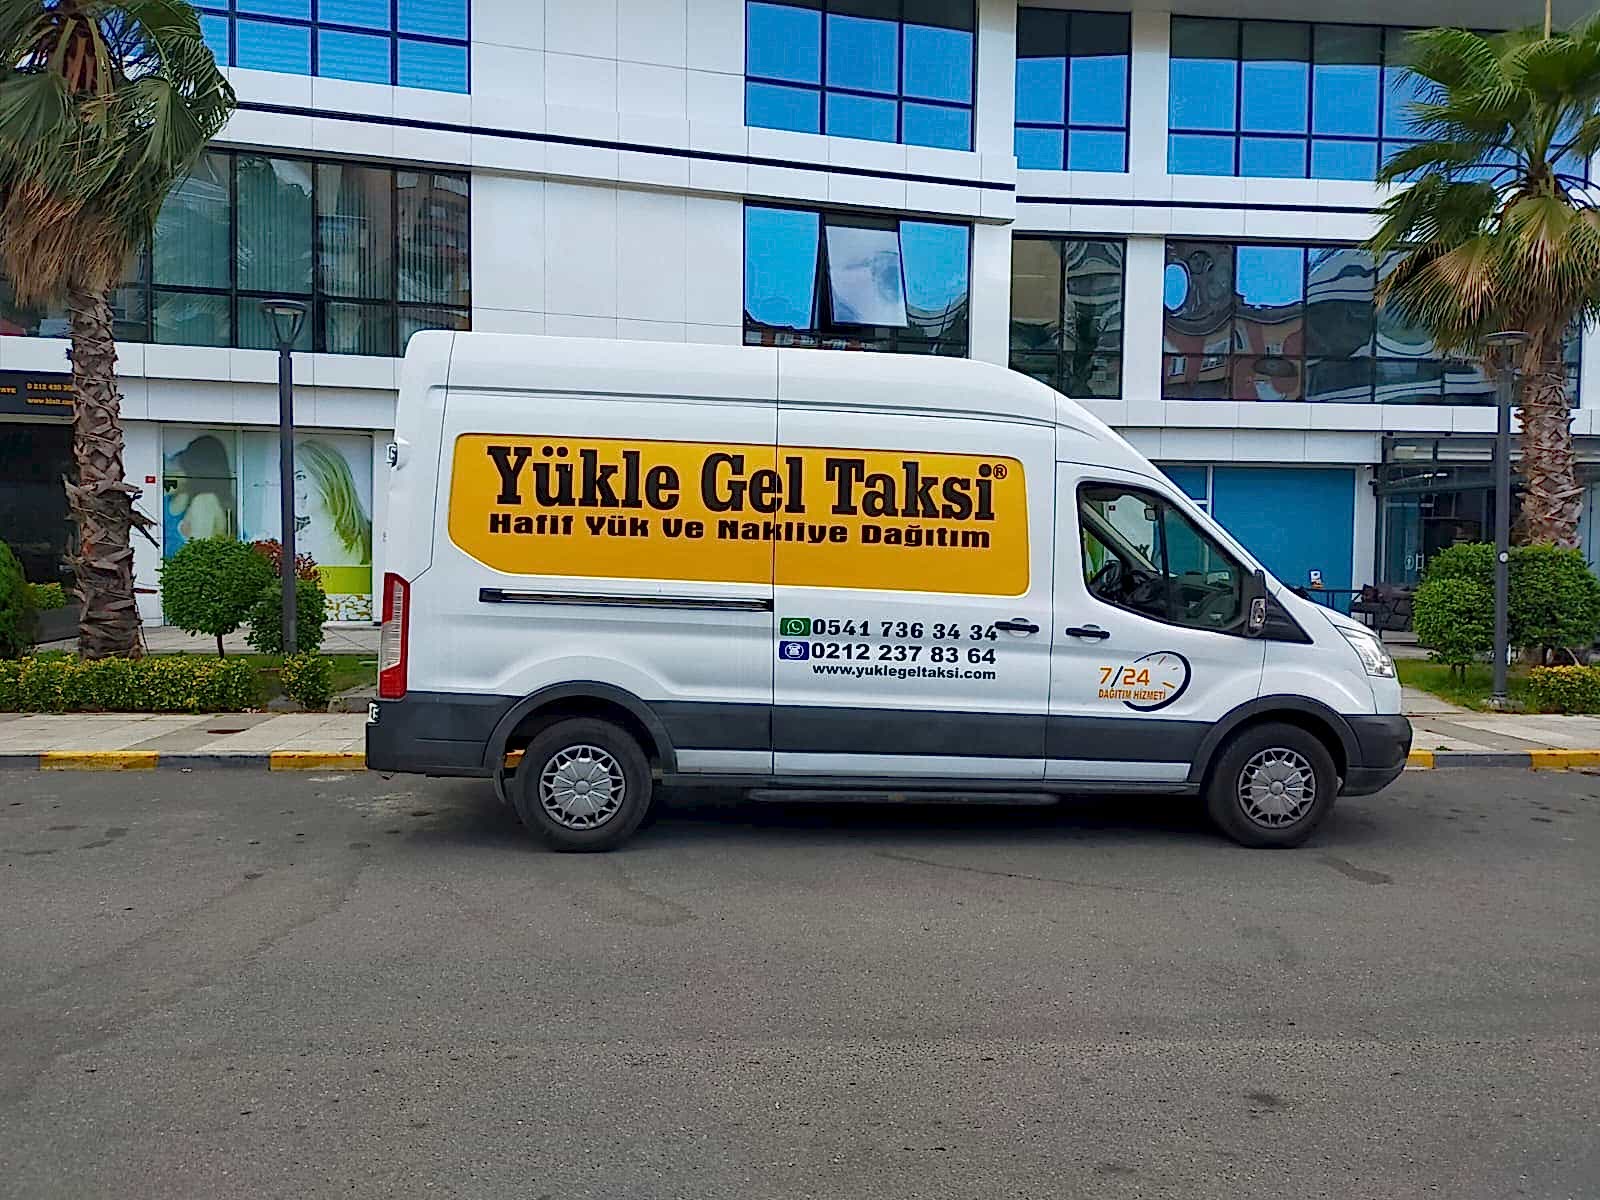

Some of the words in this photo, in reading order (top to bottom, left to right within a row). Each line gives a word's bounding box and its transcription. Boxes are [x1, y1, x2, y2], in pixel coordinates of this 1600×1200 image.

[487, 445, 680, 511] Yükle
[701, 452, 806, 514] Gel
[489, 513, 574, 535] Hafif
[585, 515, 649, 537] Yük
[662, 518, 704, 539] Ve
[718, 519, 848, 544] Nakliye
[861, 524, 990, 548] Dağıtım
[812, 618, 871, 637] 0541
[881, 621, 924, 639] 736
[932, 623, 961, 640] 34
[969, 624, 998, 641] 34
[811, 642, 870, 660] 0212
[878, 644, 922, 662] 237
[930, 646, 959, 664] 83
[967, 648, 996, 665] 64
[812, 663, 997, 680] www.yuklegeltaksi.com
[1100, 665, 1151, 688] 7/24
